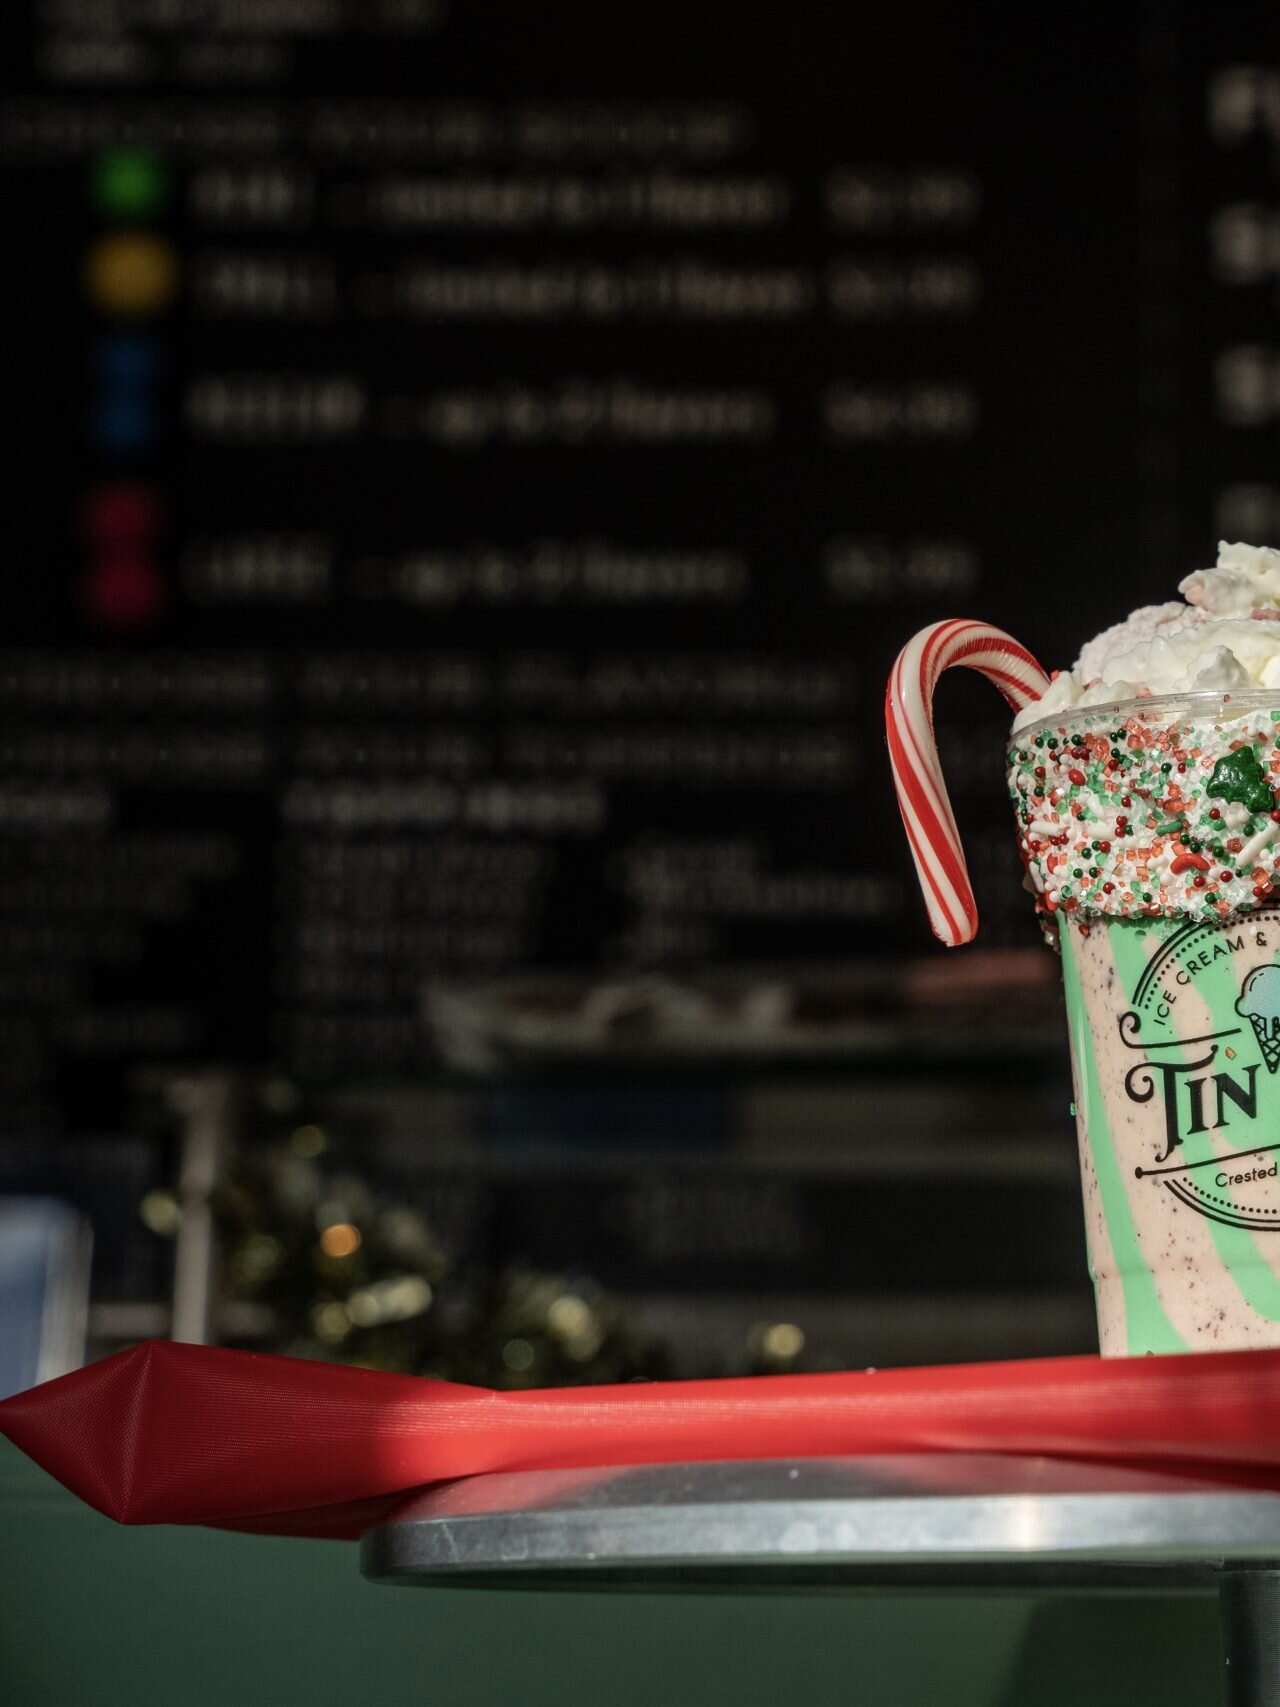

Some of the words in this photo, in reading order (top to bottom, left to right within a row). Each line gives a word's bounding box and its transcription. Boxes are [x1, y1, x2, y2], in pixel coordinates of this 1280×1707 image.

[1153, 988, 1178, 1026] ICE
[1175, 935, 1245, 986] CREAM
[1255, 931, 1268, 947] &
[1214, 1163, 1278, 1188] Crested
